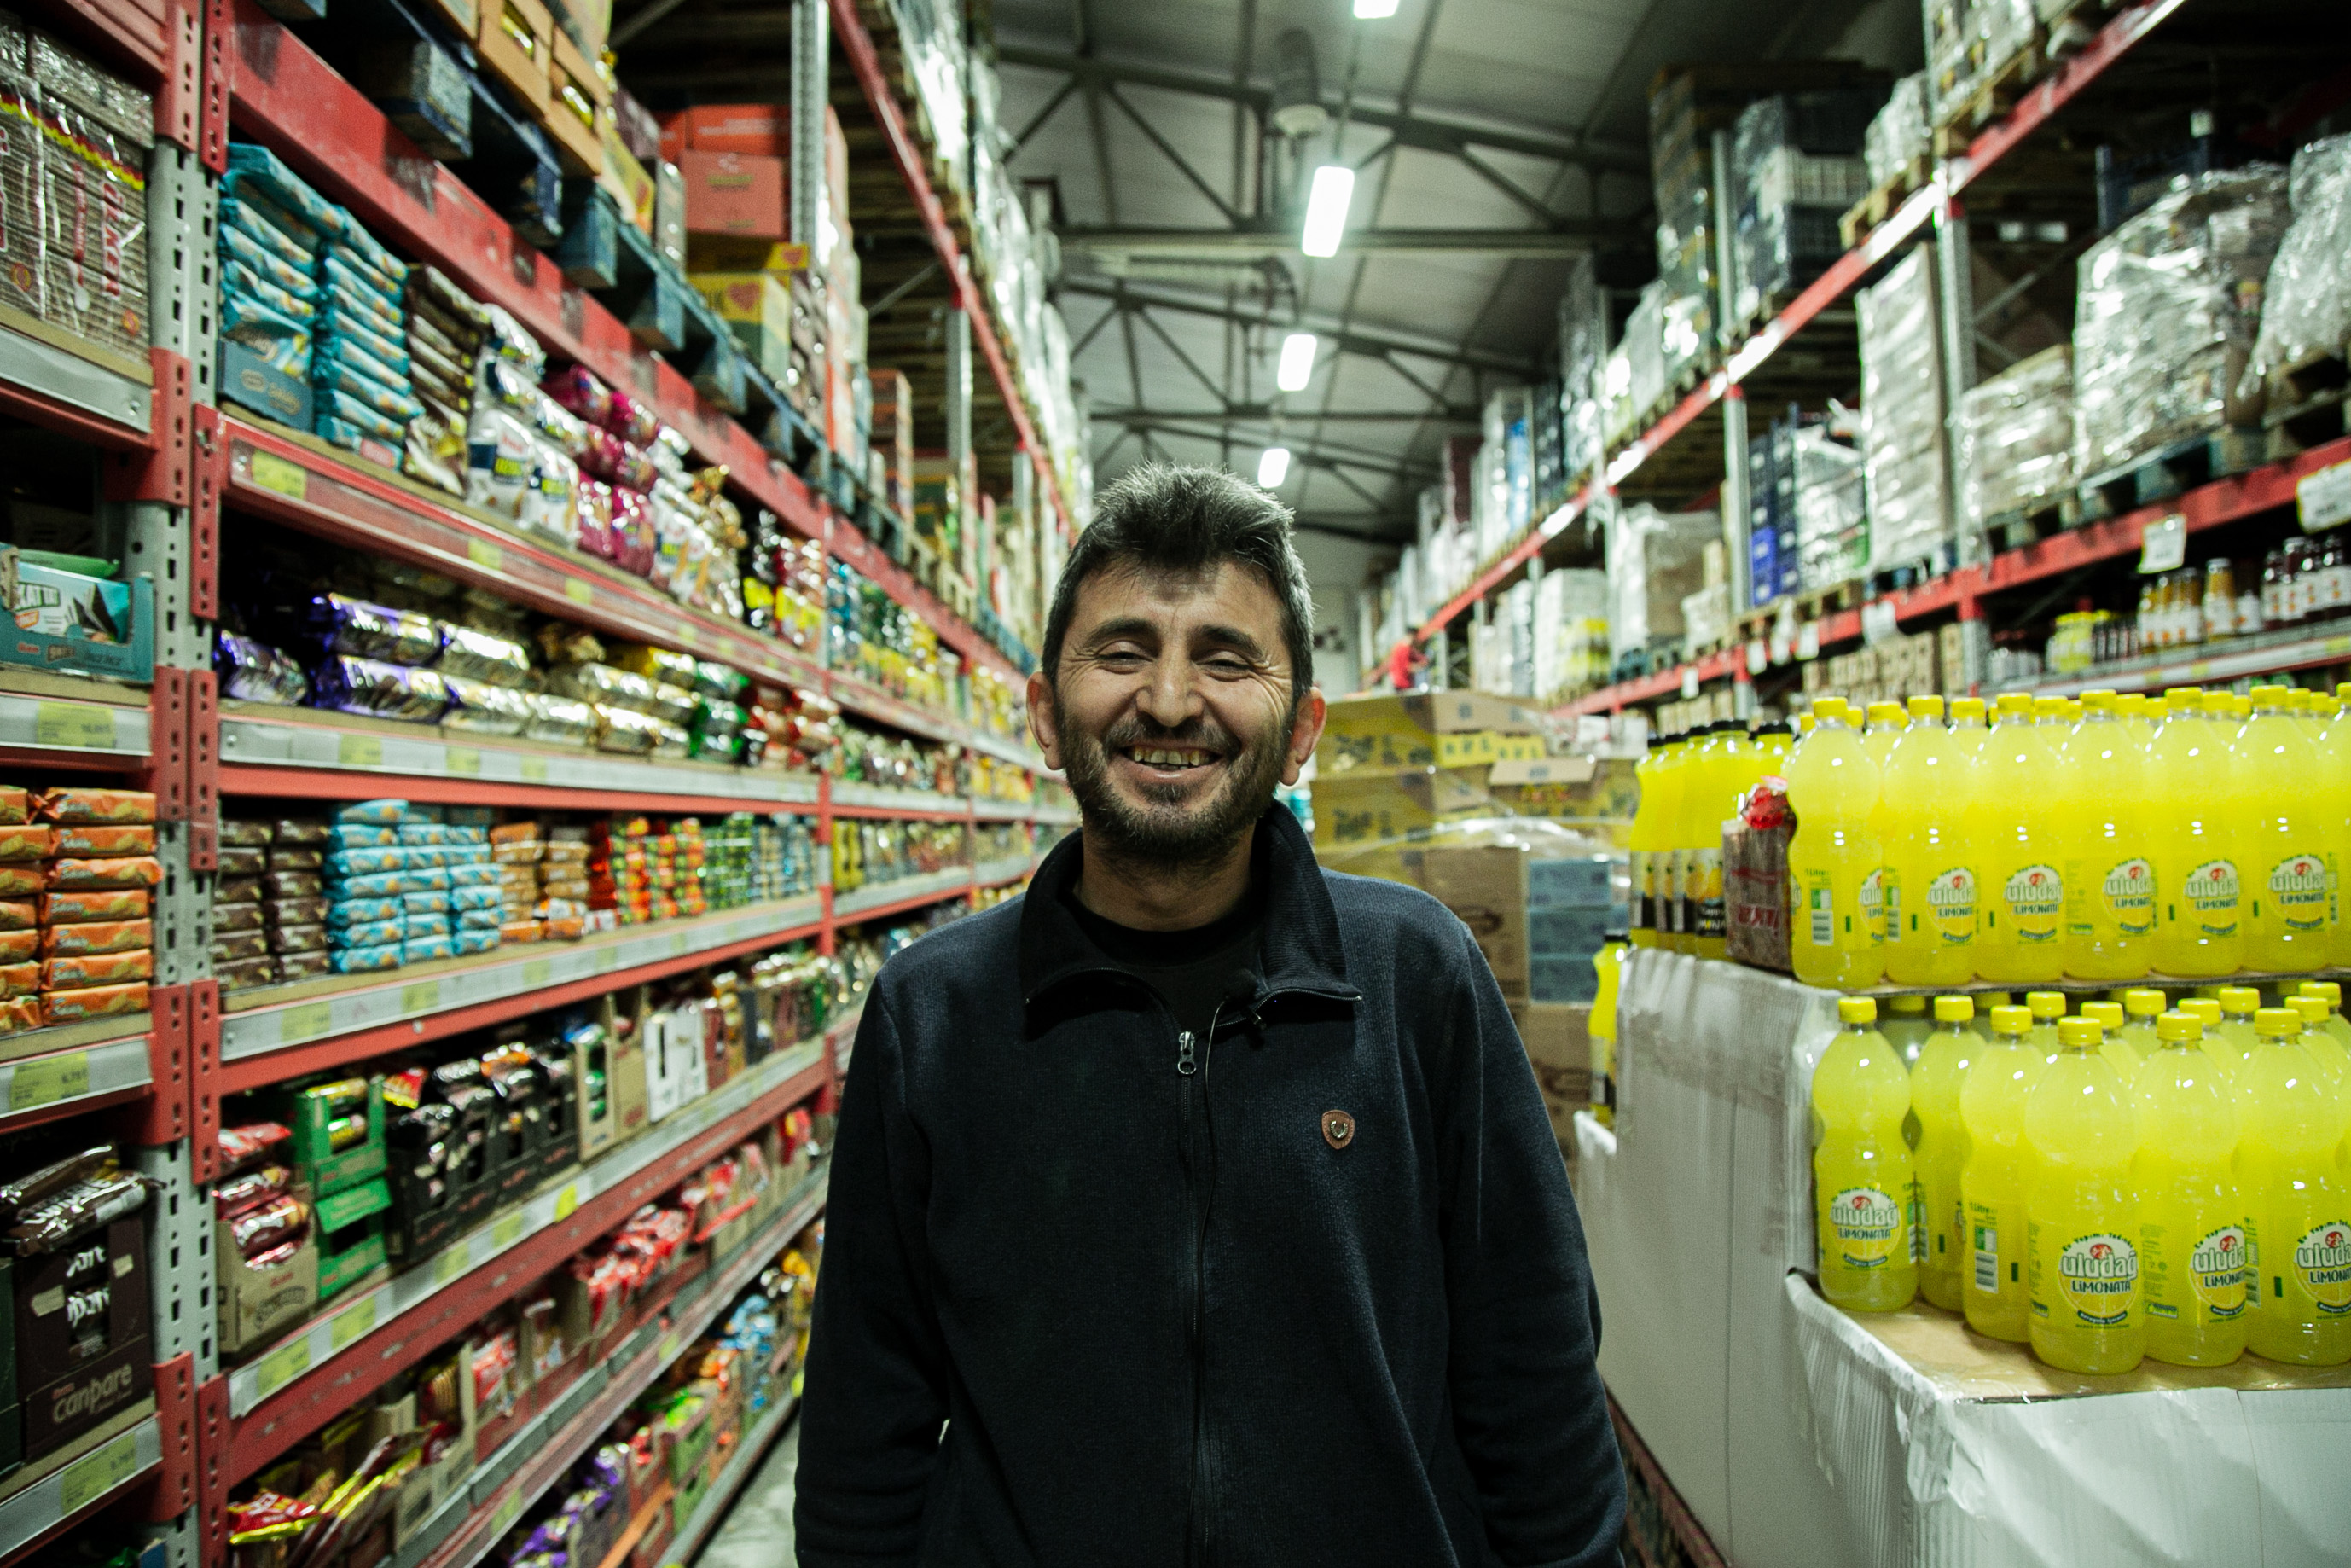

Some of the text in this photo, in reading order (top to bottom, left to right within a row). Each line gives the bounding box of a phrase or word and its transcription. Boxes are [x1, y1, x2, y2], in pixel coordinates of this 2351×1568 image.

[1831, 1202, 1899, 1230] uludağ
[2061, 1250, 2139, 1281] uludağ
[2192, 1244, 2246, 1274] uluda
